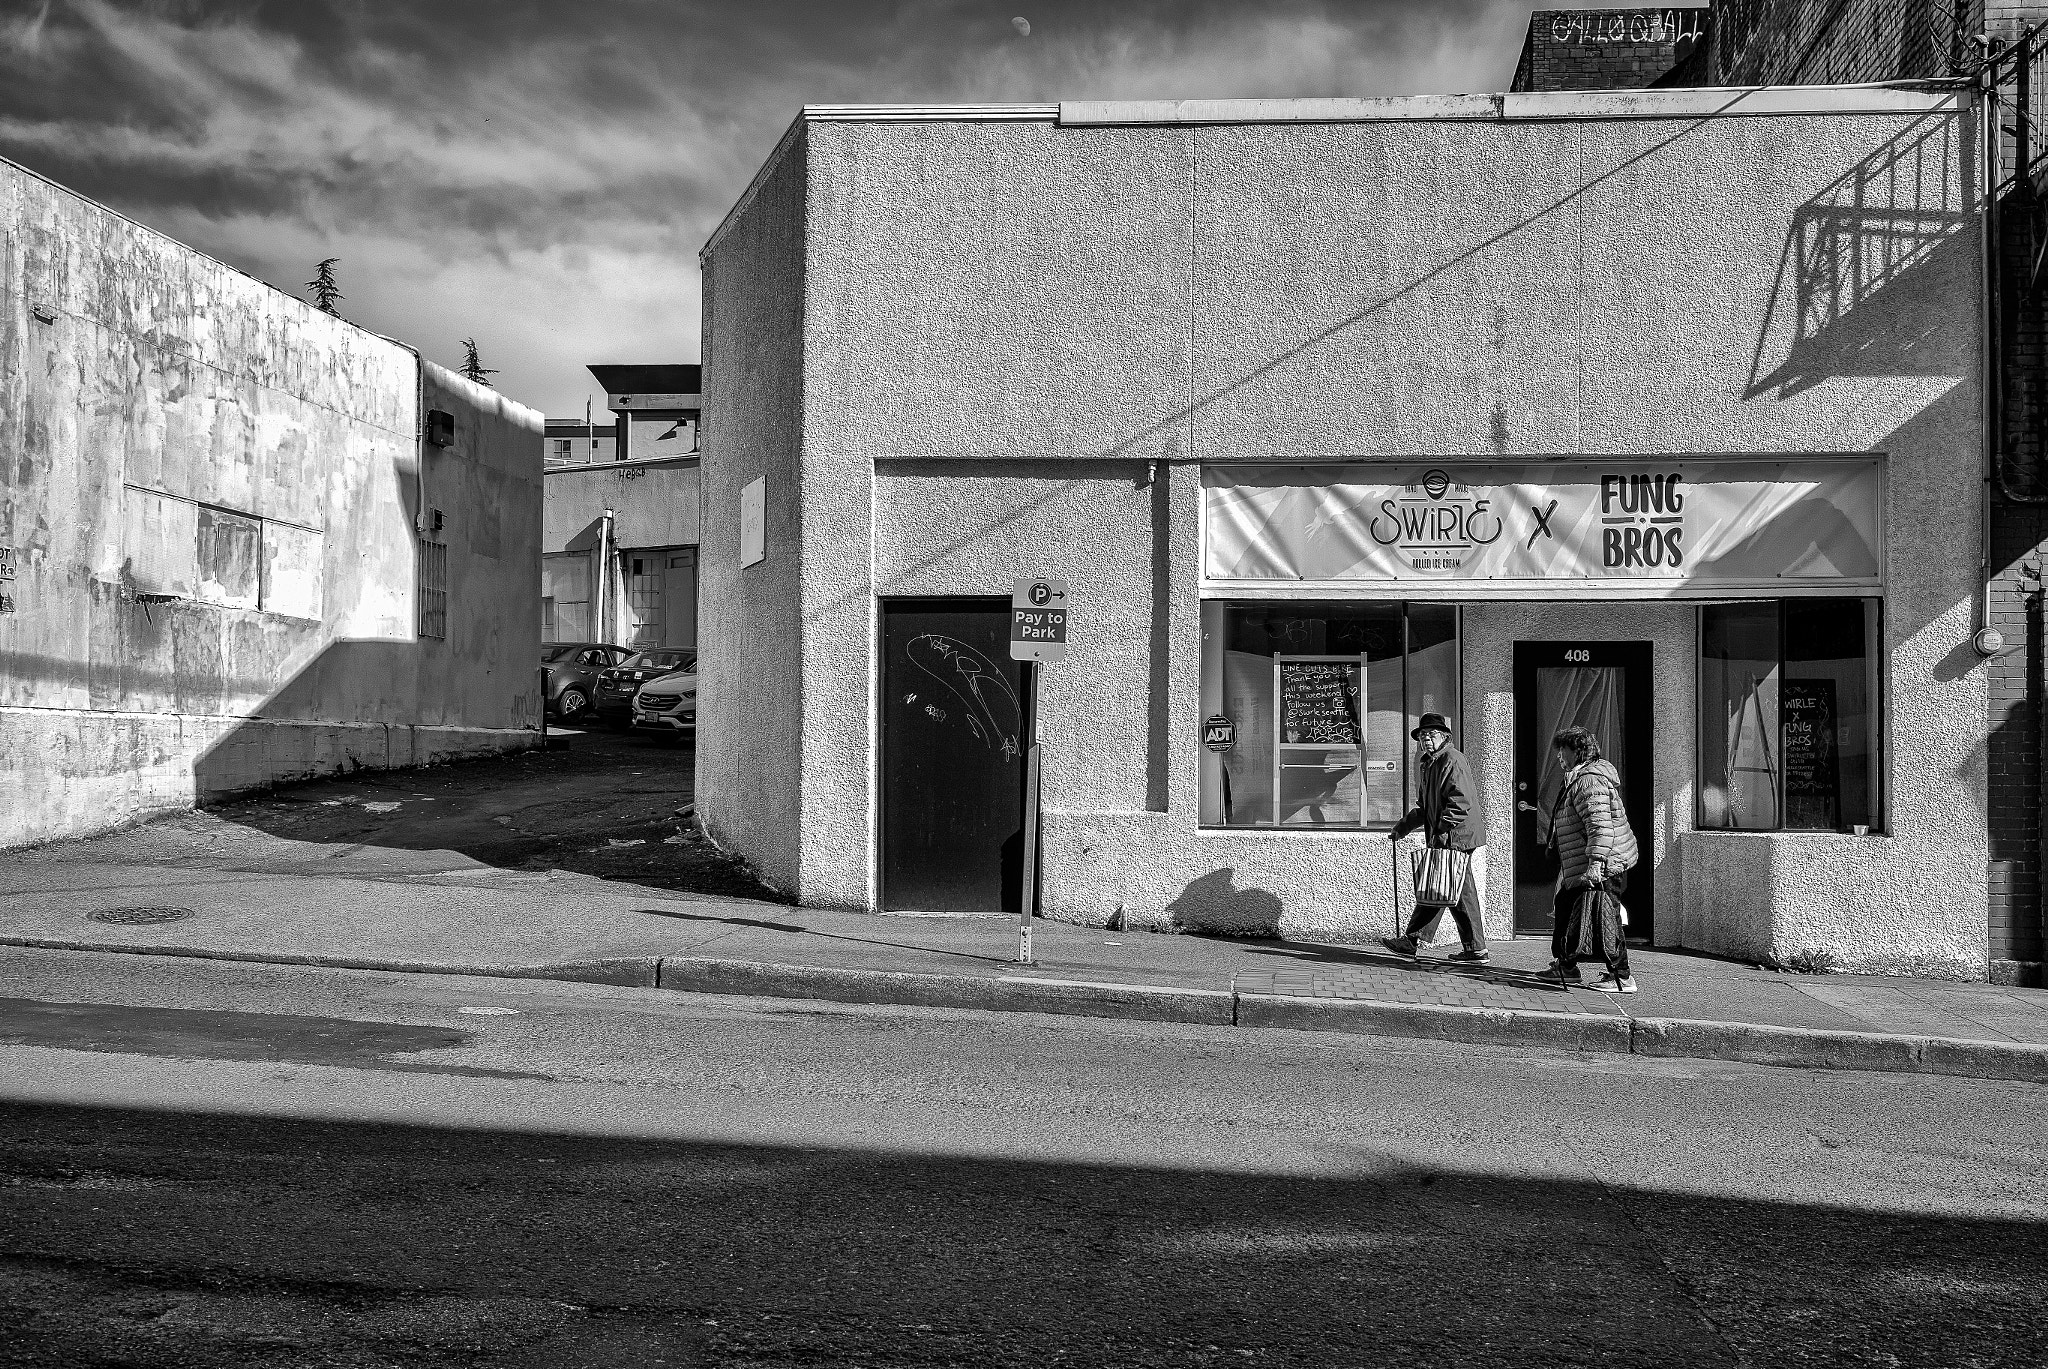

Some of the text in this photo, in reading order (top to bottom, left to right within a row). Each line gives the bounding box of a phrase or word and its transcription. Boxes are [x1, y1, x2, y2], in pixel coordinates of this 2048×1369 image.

[1600, 473, 1683, 514] FUNG
[1601, 527, 1683, 569] BROS
[1015, 611, 1063, 625] Pay to
[1022, 625, 1056, 638] Park
[1564, 649, 1590, 662] 408
[1282, 664, 1301, 672] LINE
[1282, 692, 1301, 701] this
[1284, 718, 1300, 727] for
[1207, 727, 1232, 742] ADT
